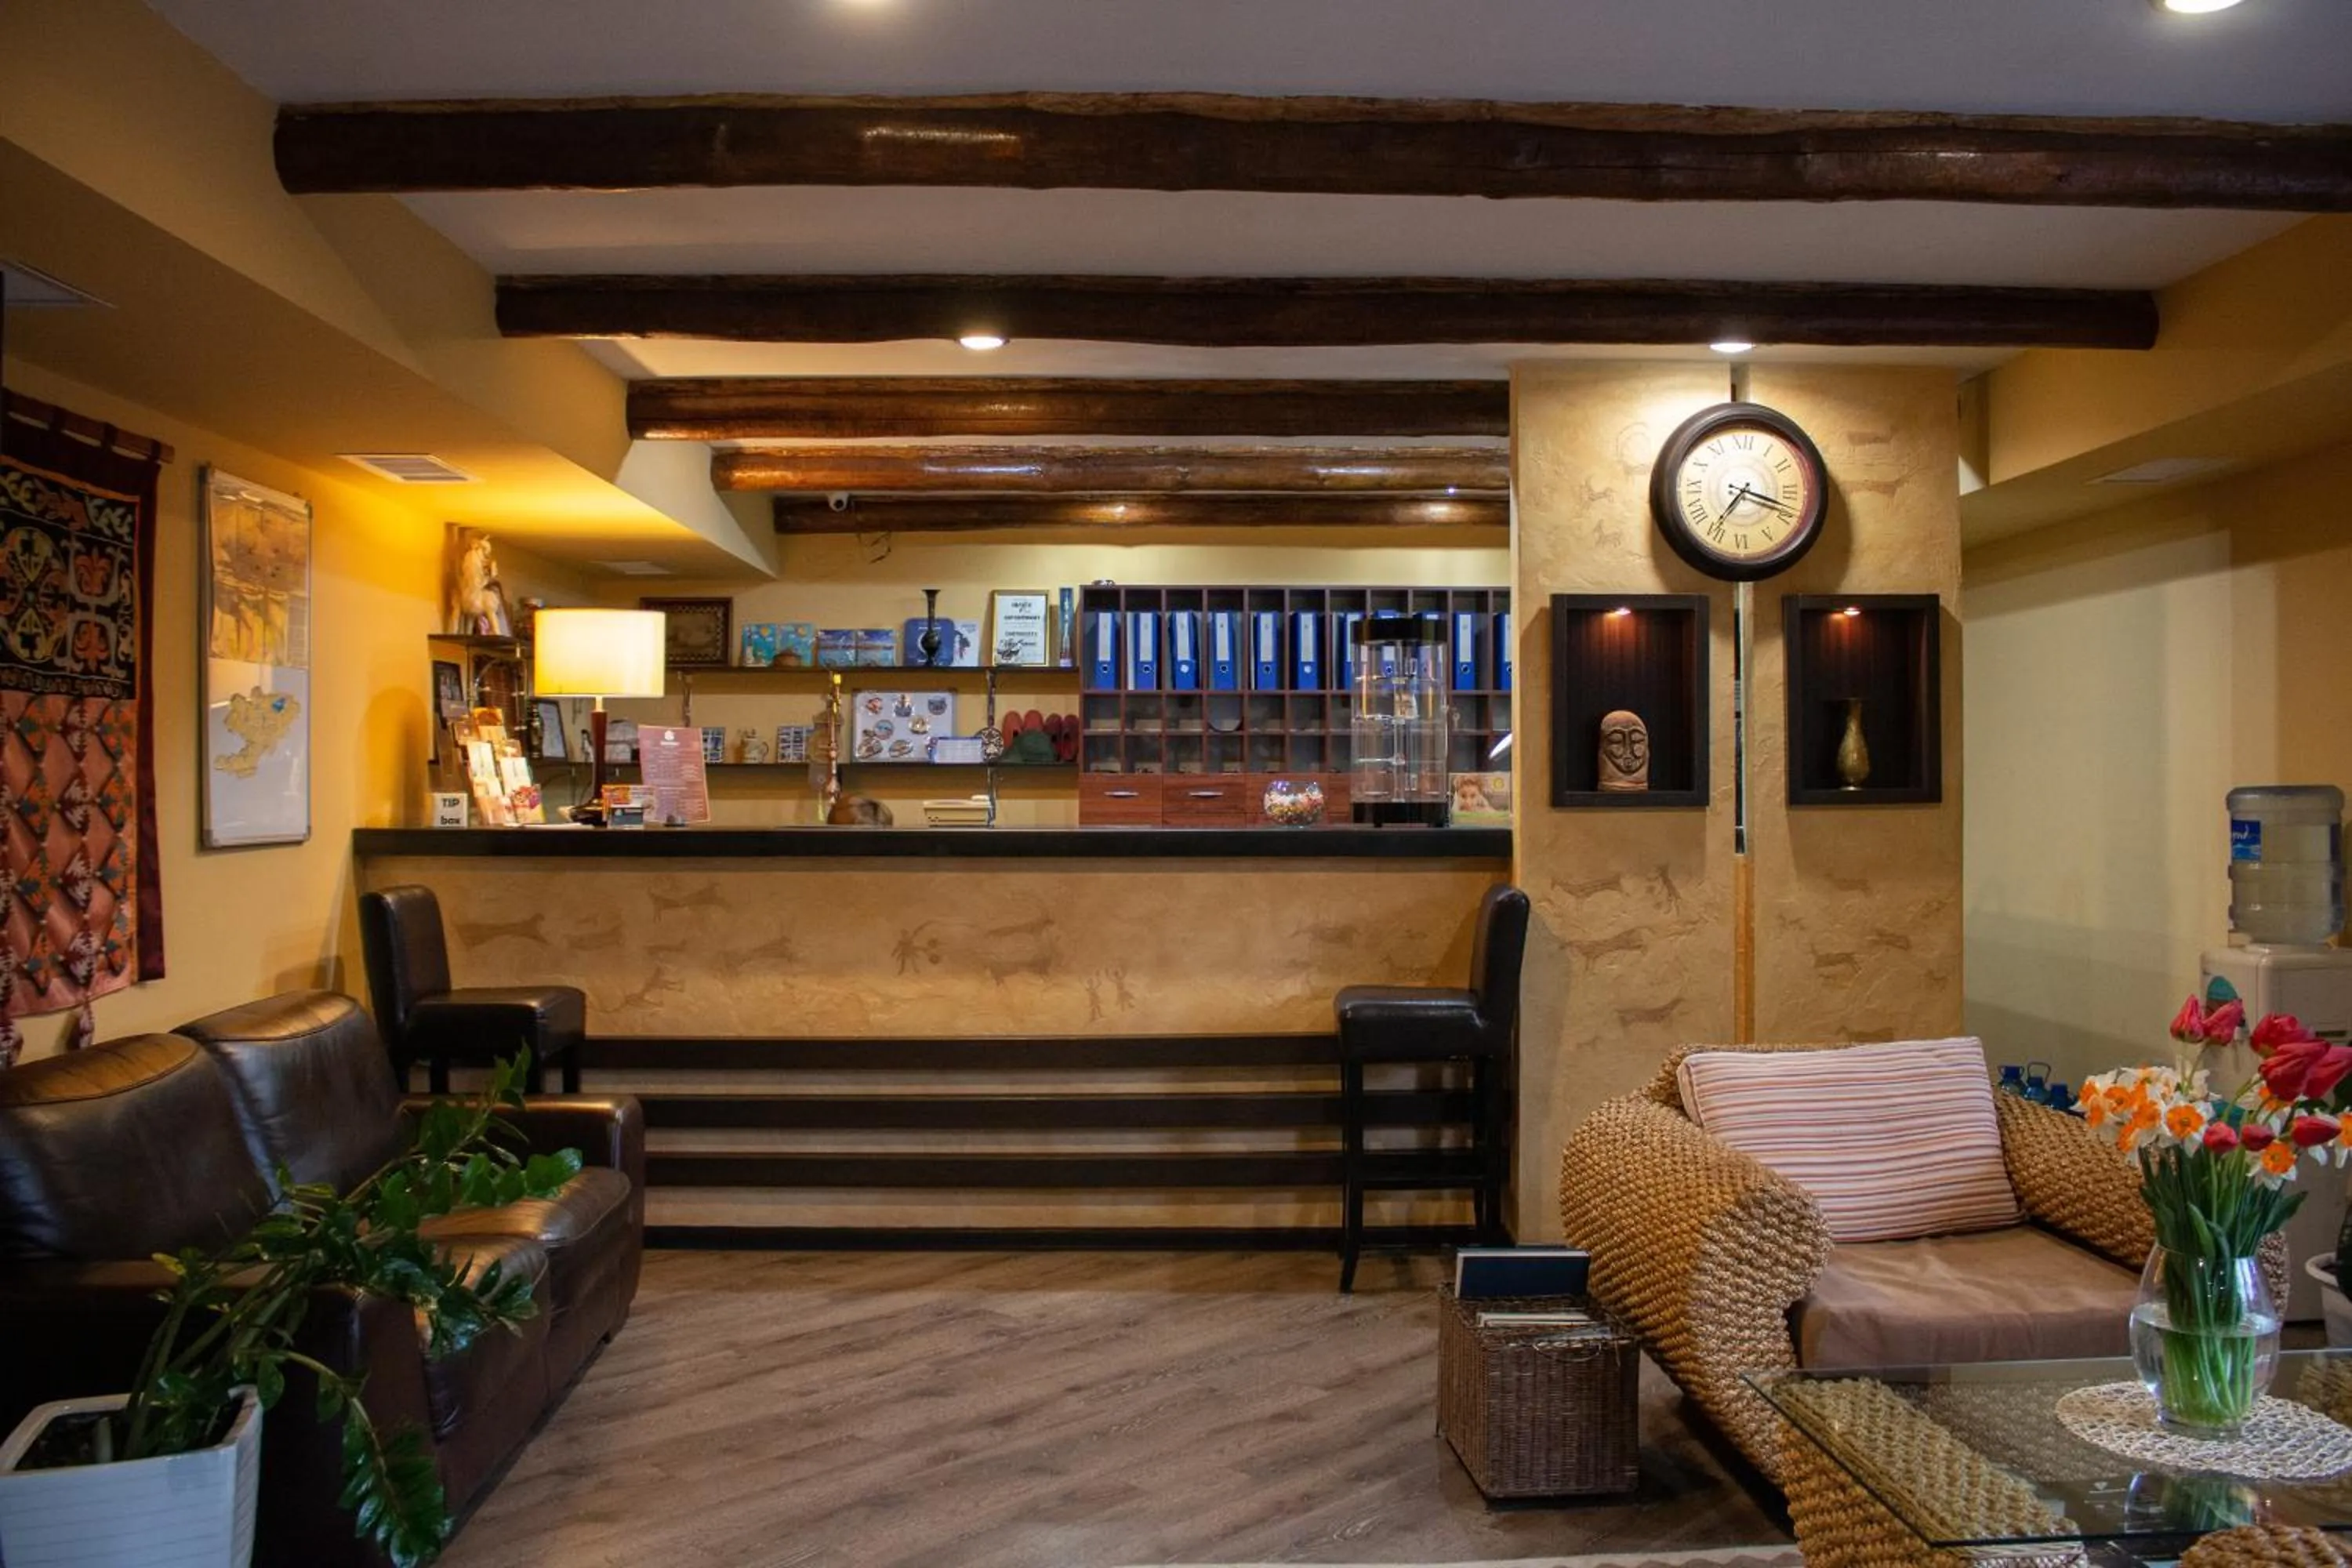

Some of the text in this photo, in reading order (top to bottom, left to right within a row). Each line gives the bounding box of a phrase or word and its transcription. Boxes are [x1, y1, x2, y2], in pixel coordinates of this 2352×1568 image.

[1732, 434, 1755, 451] XII
[1762, 444, 1773, 458] I
[1775, 458, 1791, 474] II
[1686, 478, 1702, 495] IX
[1782, 484, 1798, 501] III
[1687, 498, 1709, 525] VIII
[1733, 533, 1749, 550] VI
[1762, 526, 1773, 542] V
[441, 798, 460, 808] TIP
[440, 815, 460, 825] box
